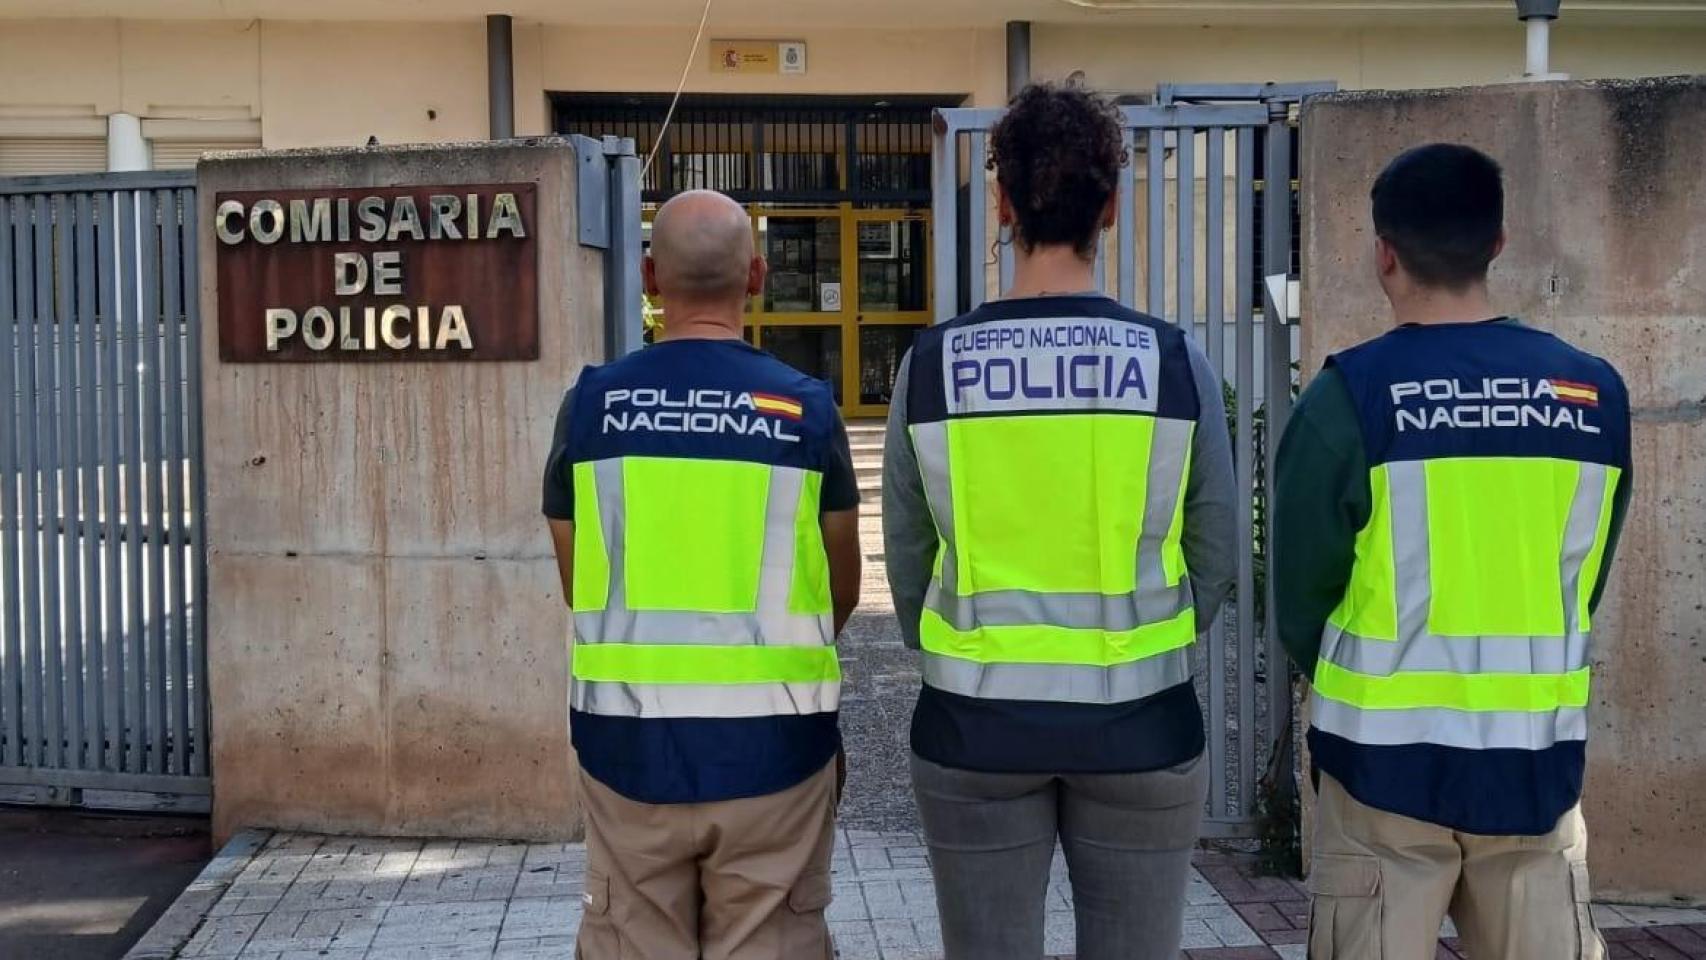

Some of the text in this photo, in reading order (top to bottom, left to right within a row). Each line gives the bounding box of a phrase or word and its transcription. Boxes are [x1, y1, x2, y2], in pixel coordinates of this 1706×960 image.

[215, 193, 526, 245] COMISARIA
[334, 251, 402, 296] DE
[265, 305, 473, 351] POLICIA
[951, 326, 1151, 353] CUERPO NACIONAL DE
[952, 355, 1148, 402] POLICIA
[602, 411, 801, 442] NACIONAL
[1395, 404, 1601, 434] NACIONAL
